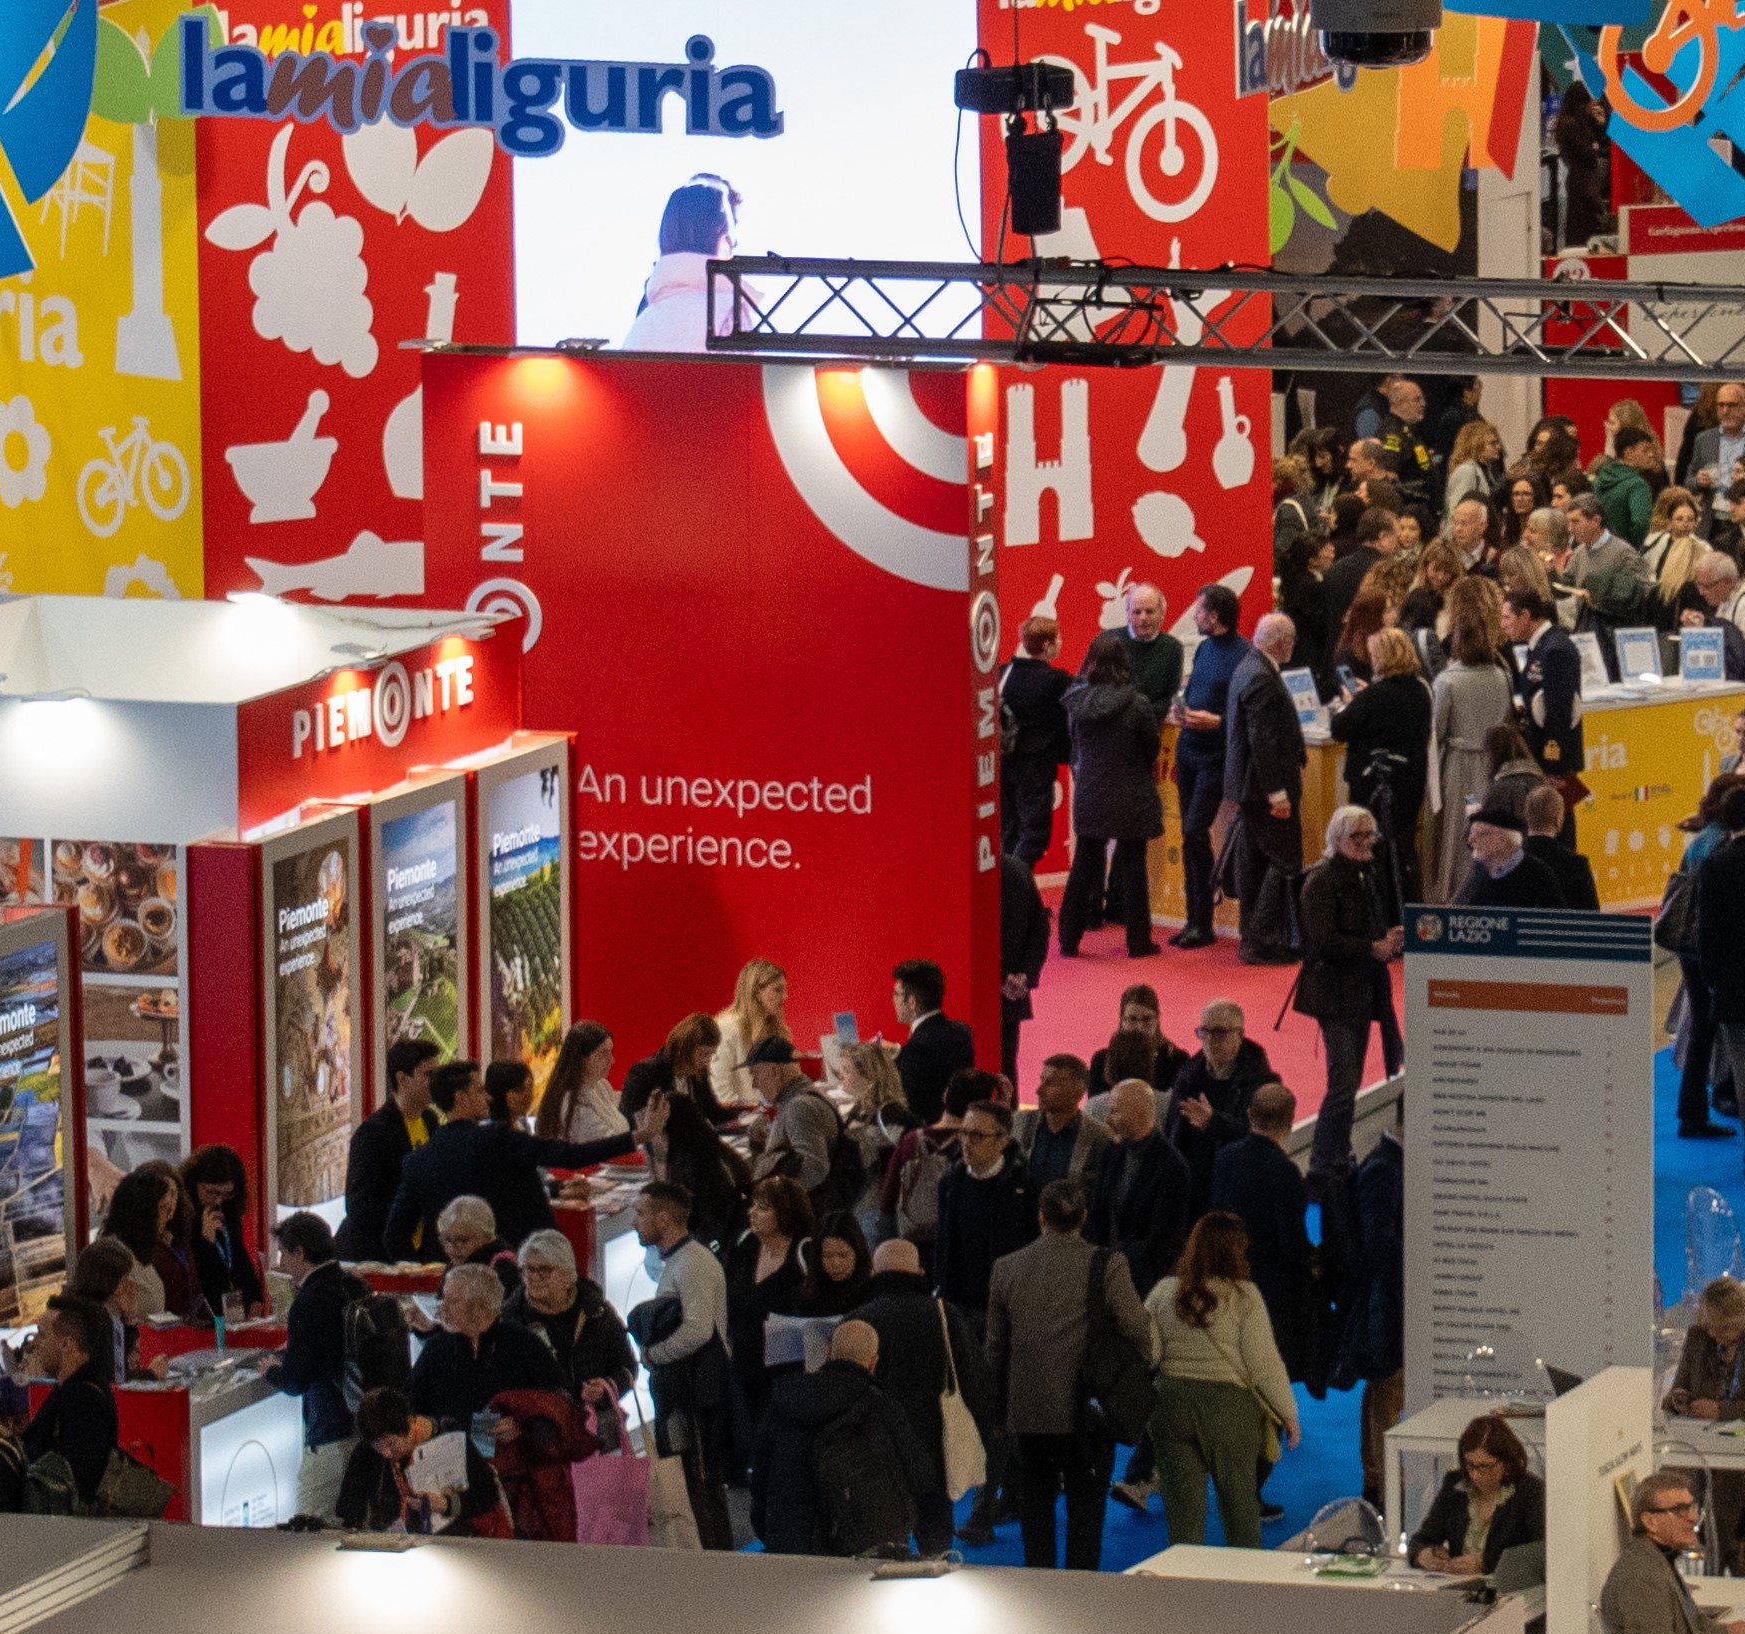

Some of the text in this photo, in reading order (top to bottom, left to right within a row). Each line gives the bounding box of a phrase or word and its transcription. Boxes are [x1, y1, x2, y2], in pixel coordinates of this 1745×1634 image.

[465, 420, 541, 654] ONTE
[970, 430, 1000, 872] PIEMONTE
[291, 653, 476, 758] PIEMONTE
[578, 764, 872, 818] An unexpected
[493, 823, 541, 857] Piemonte
[578, 827, 802, 872] experience.
[388, 858, 437, 894] Piemonte
[279, 897, 329, 934] Piemonte
[1448, 915, 1510, 931] REGIONE
[1448, 928, 1492, 944] LAZIO
